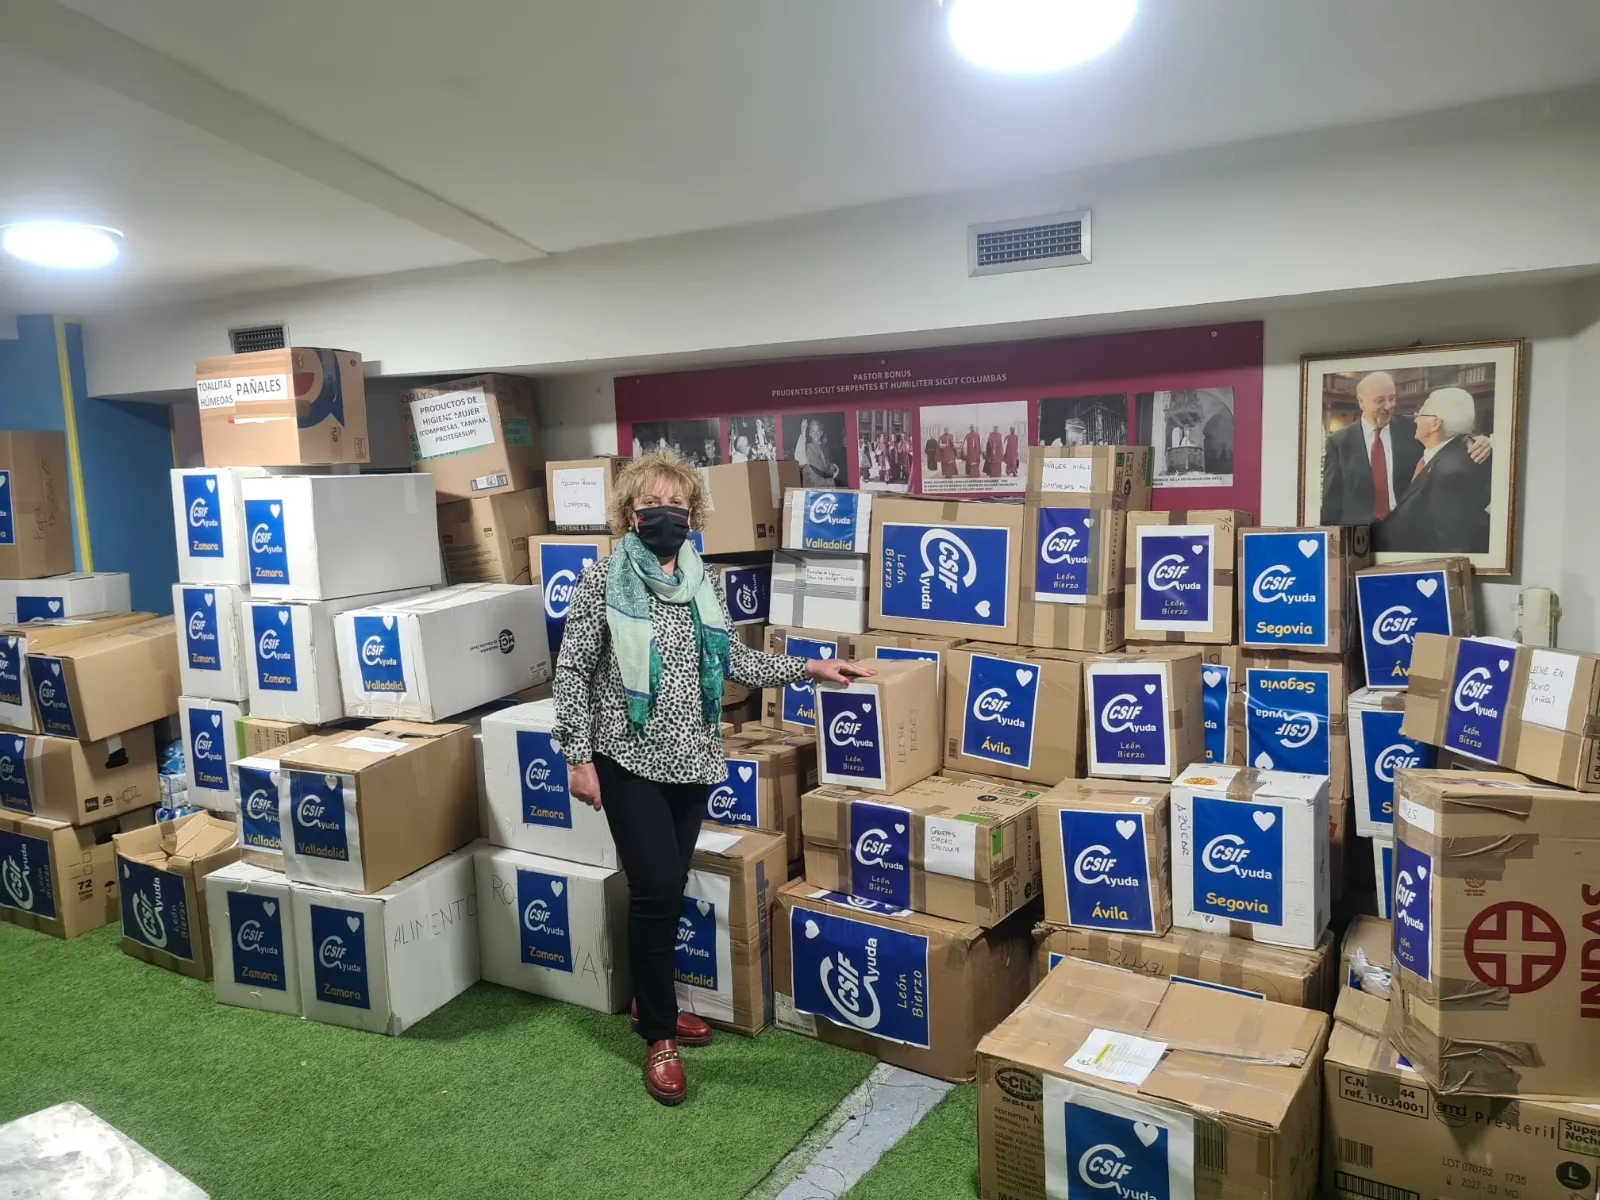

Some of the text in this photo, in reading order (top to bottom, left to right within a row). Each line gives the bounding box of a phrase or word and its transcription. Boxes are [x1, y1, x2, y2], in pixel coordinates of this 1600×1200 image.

[853, 369, 912, 382] PASTOR BONUS
[198, 379, 232, 393] TOALLITAS
[236, 378, 282, 397] PAÑALES
[772, 373, 1007, 398] PRUDENTES SICUT SERPENTES ET HUMILITER SICUT COLUMBAS
[420, 395, 477, 415] PRODUCTOS DE
[193, 541, 219, 551] Zamora
[805, 538, 852, 550] Valladolid
[256, 567, 284, 578] Zamora
[885, 548, 895, 589] Bierzo
[896, 554, 906, 584] León
[1056, 572, 1076, 580] León
[1053, 581, 1079, 589] Bierzo
[1256, 622, 1313, 638] Segovia
[192, 652, 216, 664] Zamora
[263, 673, 292, 684] Zamora
[365, 680, 404, 691] Valladolid
[1260, 677, 1316, 694] Segovia
[1463, 724, 1480, 737] León
[982, 736, 1012, 755] Ávila
[1458, 734, 1482, 749] Bierzo
[1117, 750, 1145, 758] Bierzo
[198, 772, 224, 784] Zamora
[530, 805, 564, 820] Zamora
[298, 842, 346, 859] Valladolid
[77, 878, 93, 890] 72
[872, 875, 890, 885] León
[868, 883, 893, 895] Bierzo
[1206, 892, 1269, 914] Segovia
[1092, 902, 1128, 920] Ávila
[676, 928, 696, 942] SIF
[528, 946, 564, 963] Zamora
[241, 966, 278, 982] Zamora
[323, 982, 361, 1000] Zamora
[896, 973, 908, 1009] León
[911, 970, 924, 1018] Bierzo
[1344, 1088, 1424, 1114] ref. 11034001
[1442, 1157, 1460, 1169] LOT
[1504, 1172, 1527, 1186] 1735
[1568, 1166, 1578, 1180] L
